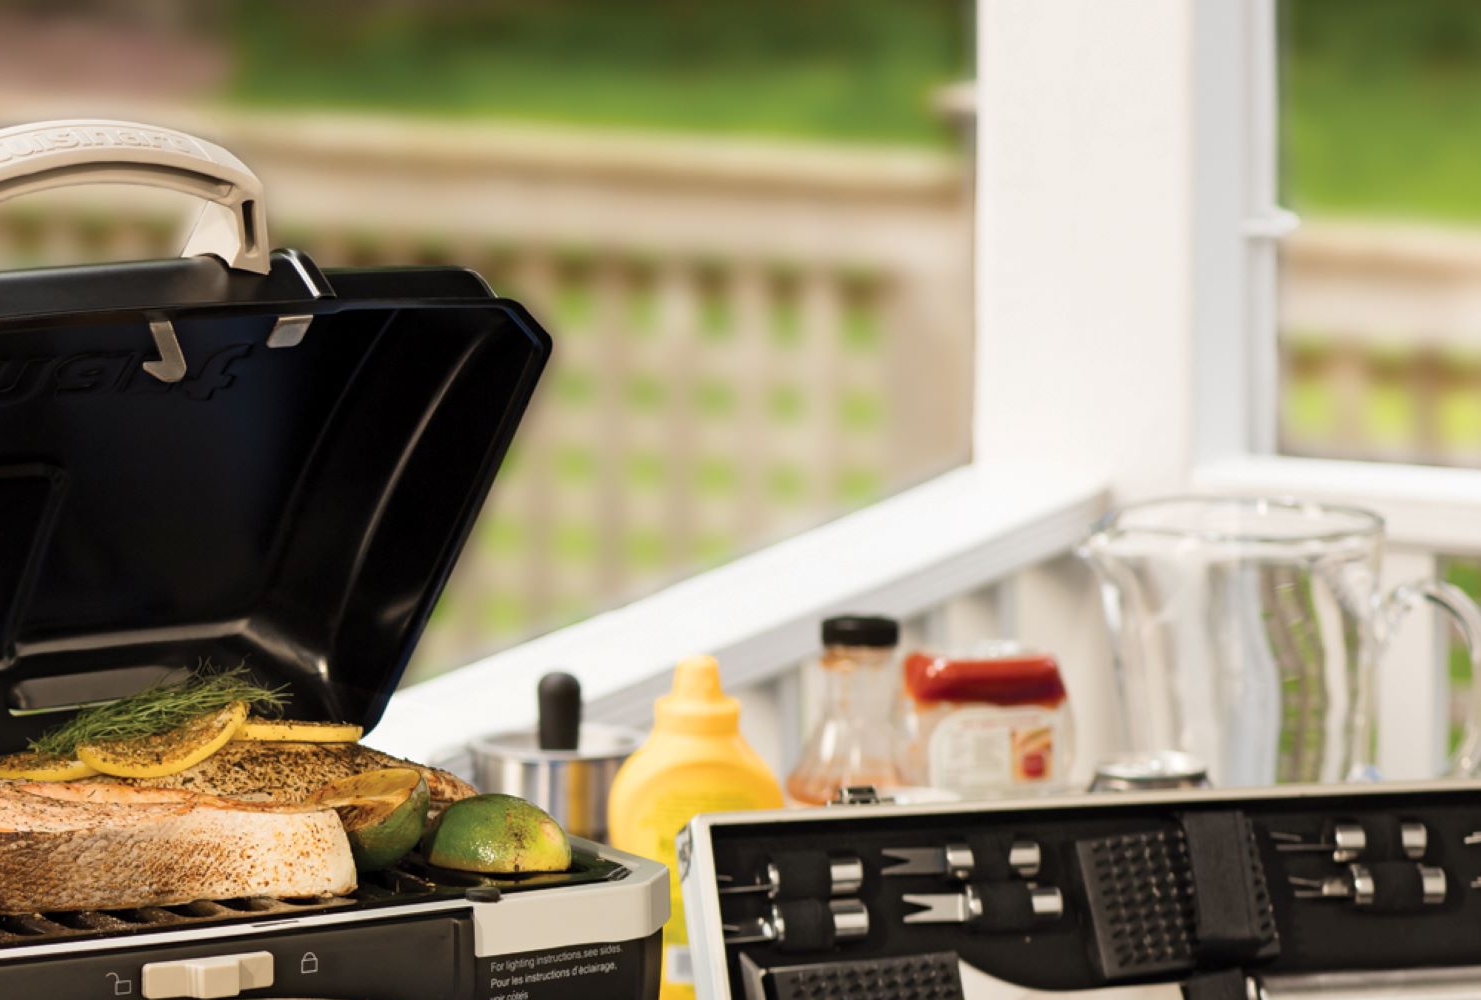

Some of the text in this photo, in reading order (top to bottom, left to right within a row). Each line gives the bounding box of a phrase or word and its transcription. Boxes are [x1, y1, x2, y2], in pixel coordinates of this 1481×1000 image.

[491, 962, 504, 973] For
[506, 958, 534, 972] lighting
[600, 944, 622, 955] sides.
[491, 977, 509, 989] Pour
[511, 976, 523, 986] les
[525, 967, 570, 983] instructions
